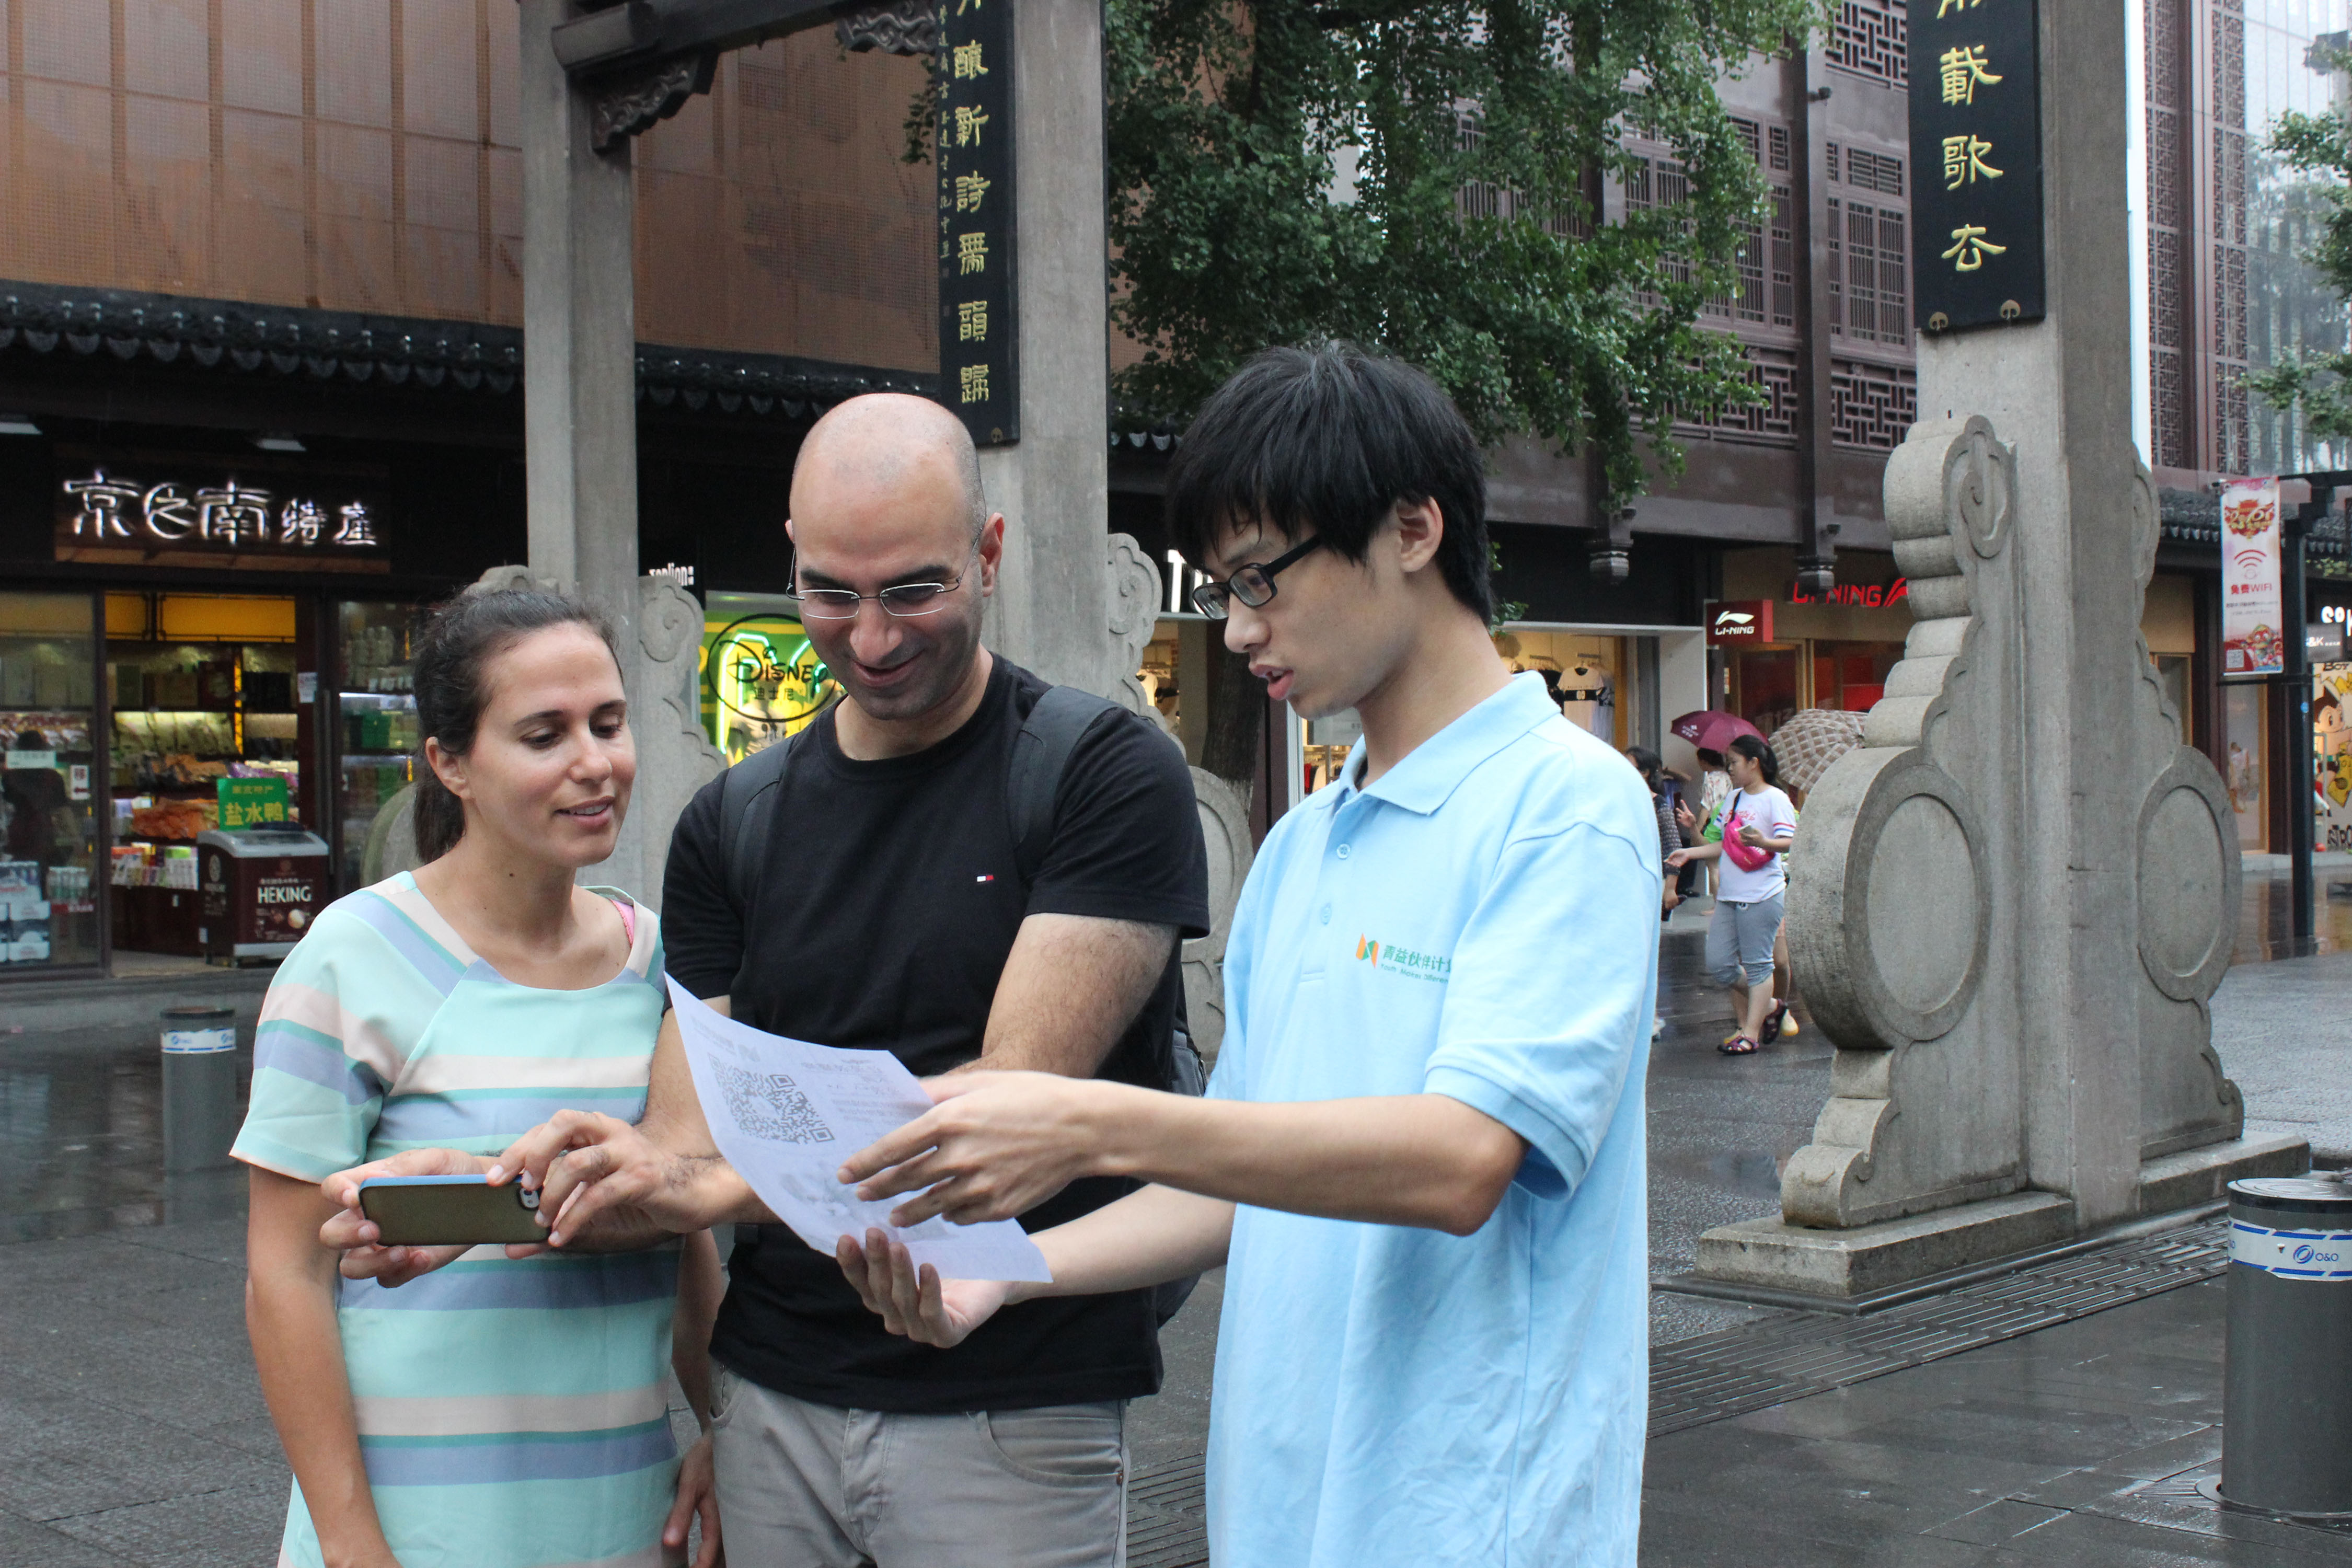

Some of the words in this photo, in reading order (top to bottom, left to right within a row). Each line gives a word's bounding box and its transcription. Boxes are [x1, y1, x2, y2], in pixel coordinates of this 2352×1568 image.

[1937, 0, 2006, 271] 載歌去
[1793, 582, 1883, 607] LNING
[1715, 626, 1755, 636] LI-NING
[755, 686, 794, 700] 迪士尼
[225, 802, 284, 825] 盐水鸭
[257, 886, 313, 904] HEKING
[2315, 1253, 2339, 1262] O&O
